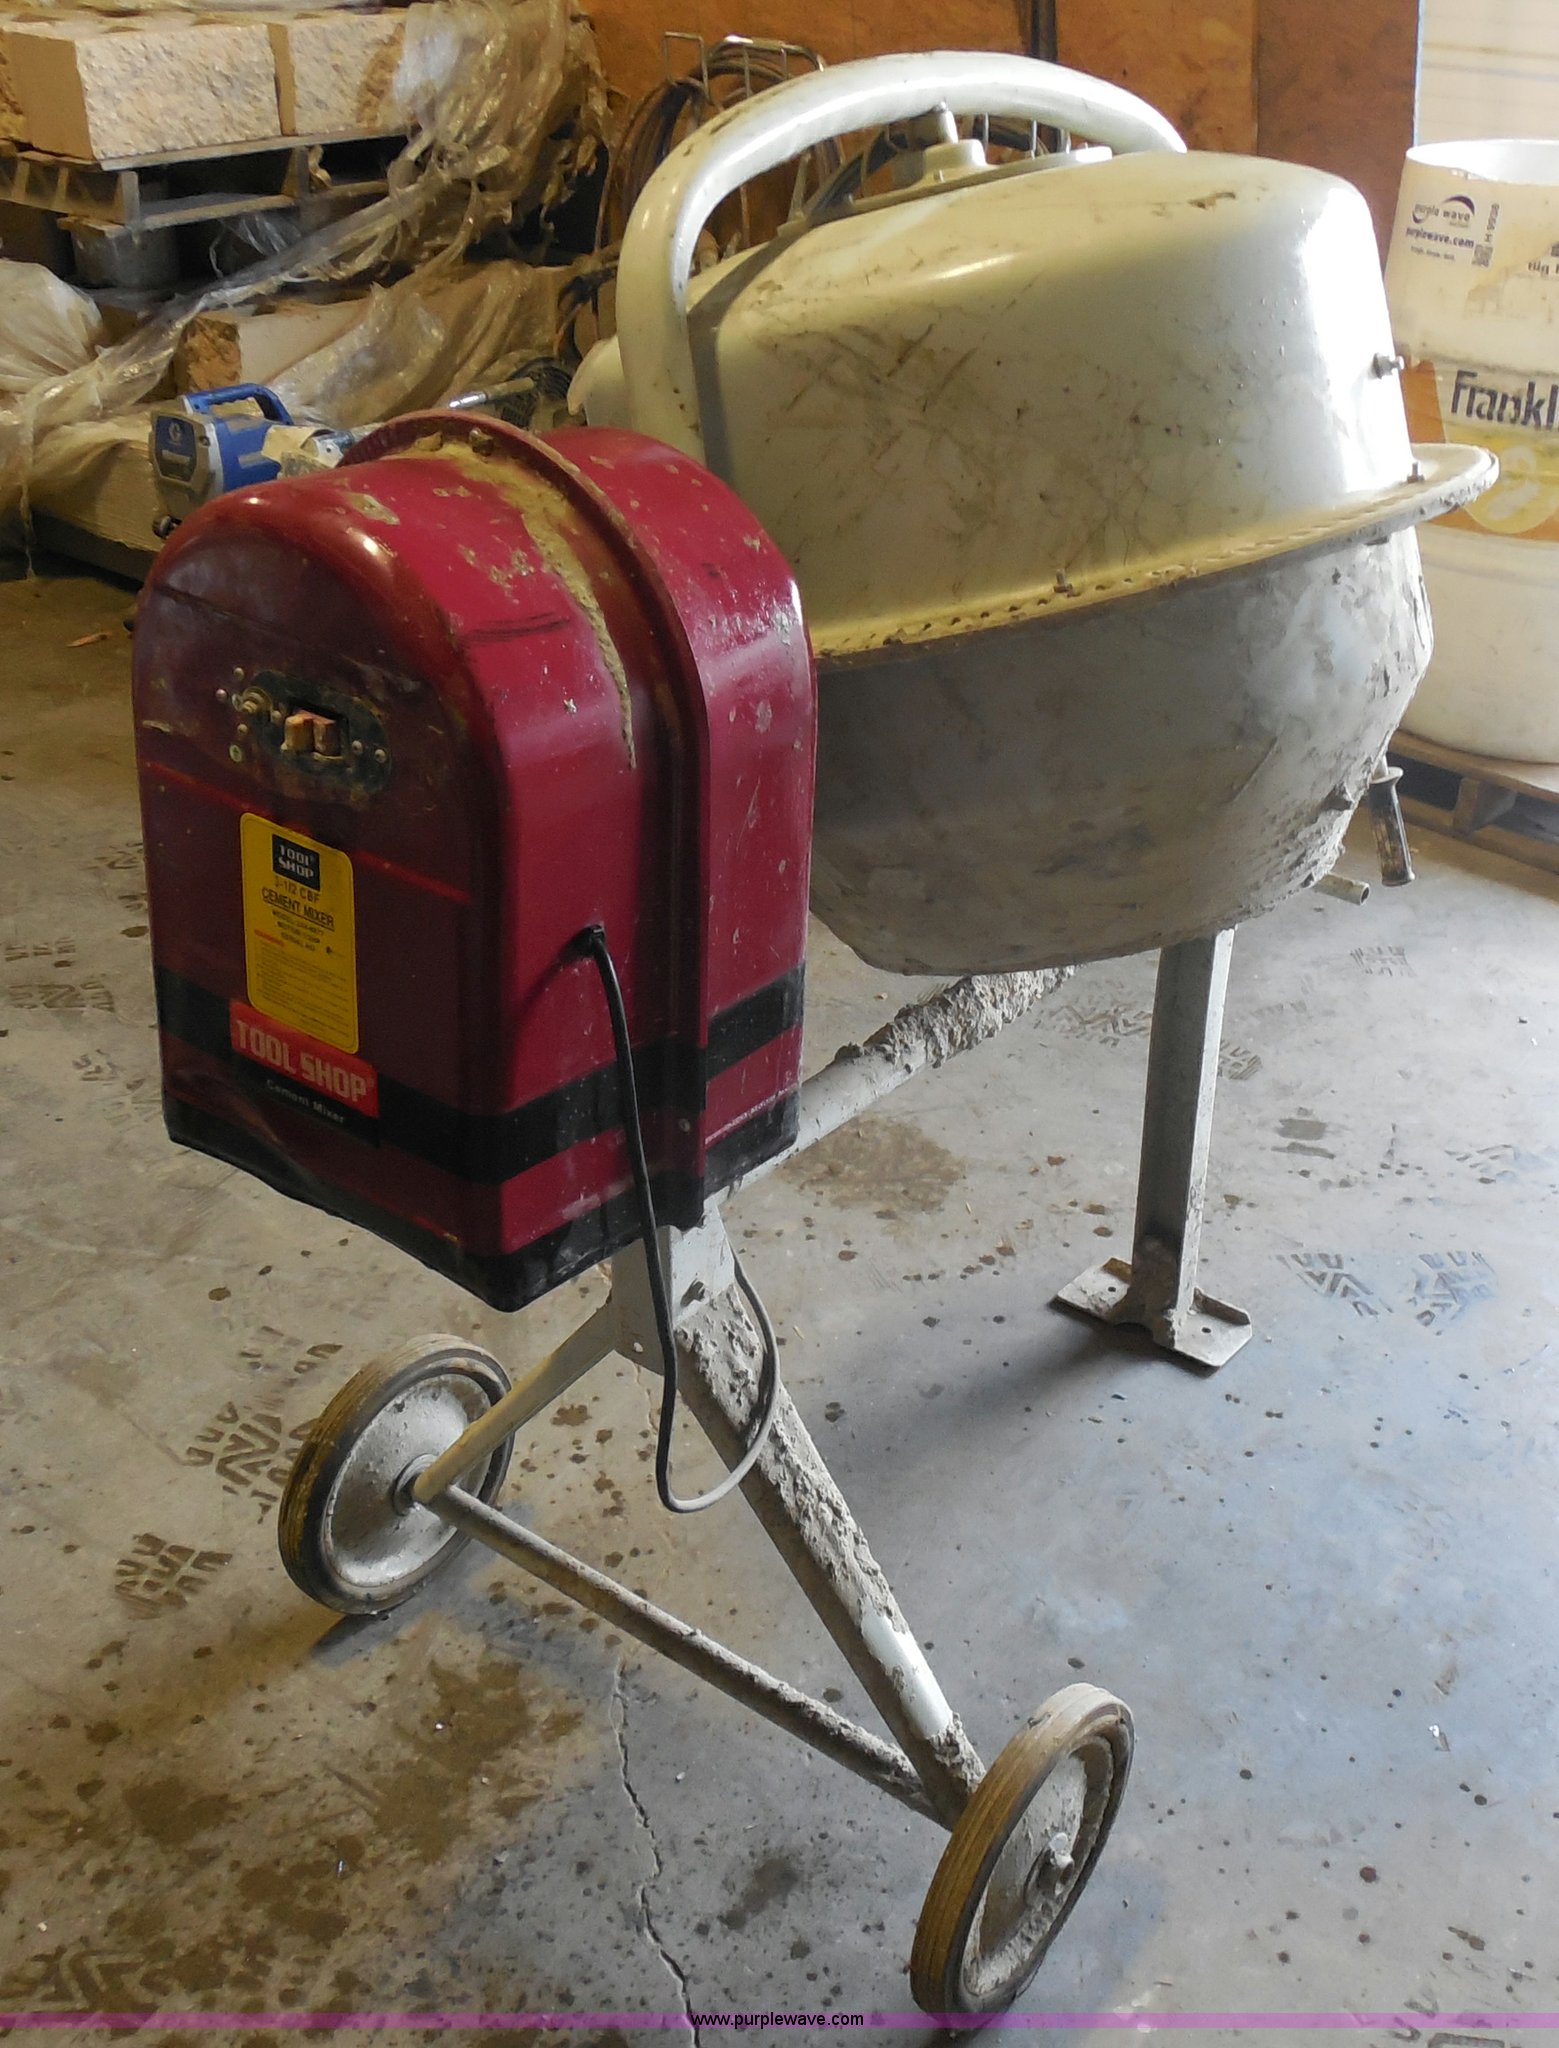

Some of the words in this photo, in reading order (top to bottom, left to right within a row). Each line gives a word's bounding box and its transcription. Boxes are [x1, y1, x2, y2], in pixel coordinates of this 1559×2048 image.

[278, 856, 315, 879] SHOP
[261, 886, 301, 913] CEMENT
[303, 904, 335, 928] MIXER
[236, 1019, 297, 1075] TOOL
[299, 1051, 367, 1102] SHOP
[266, 1078, 309, 1106] Cement
[312, 1100, 344, 1124] Mixer
